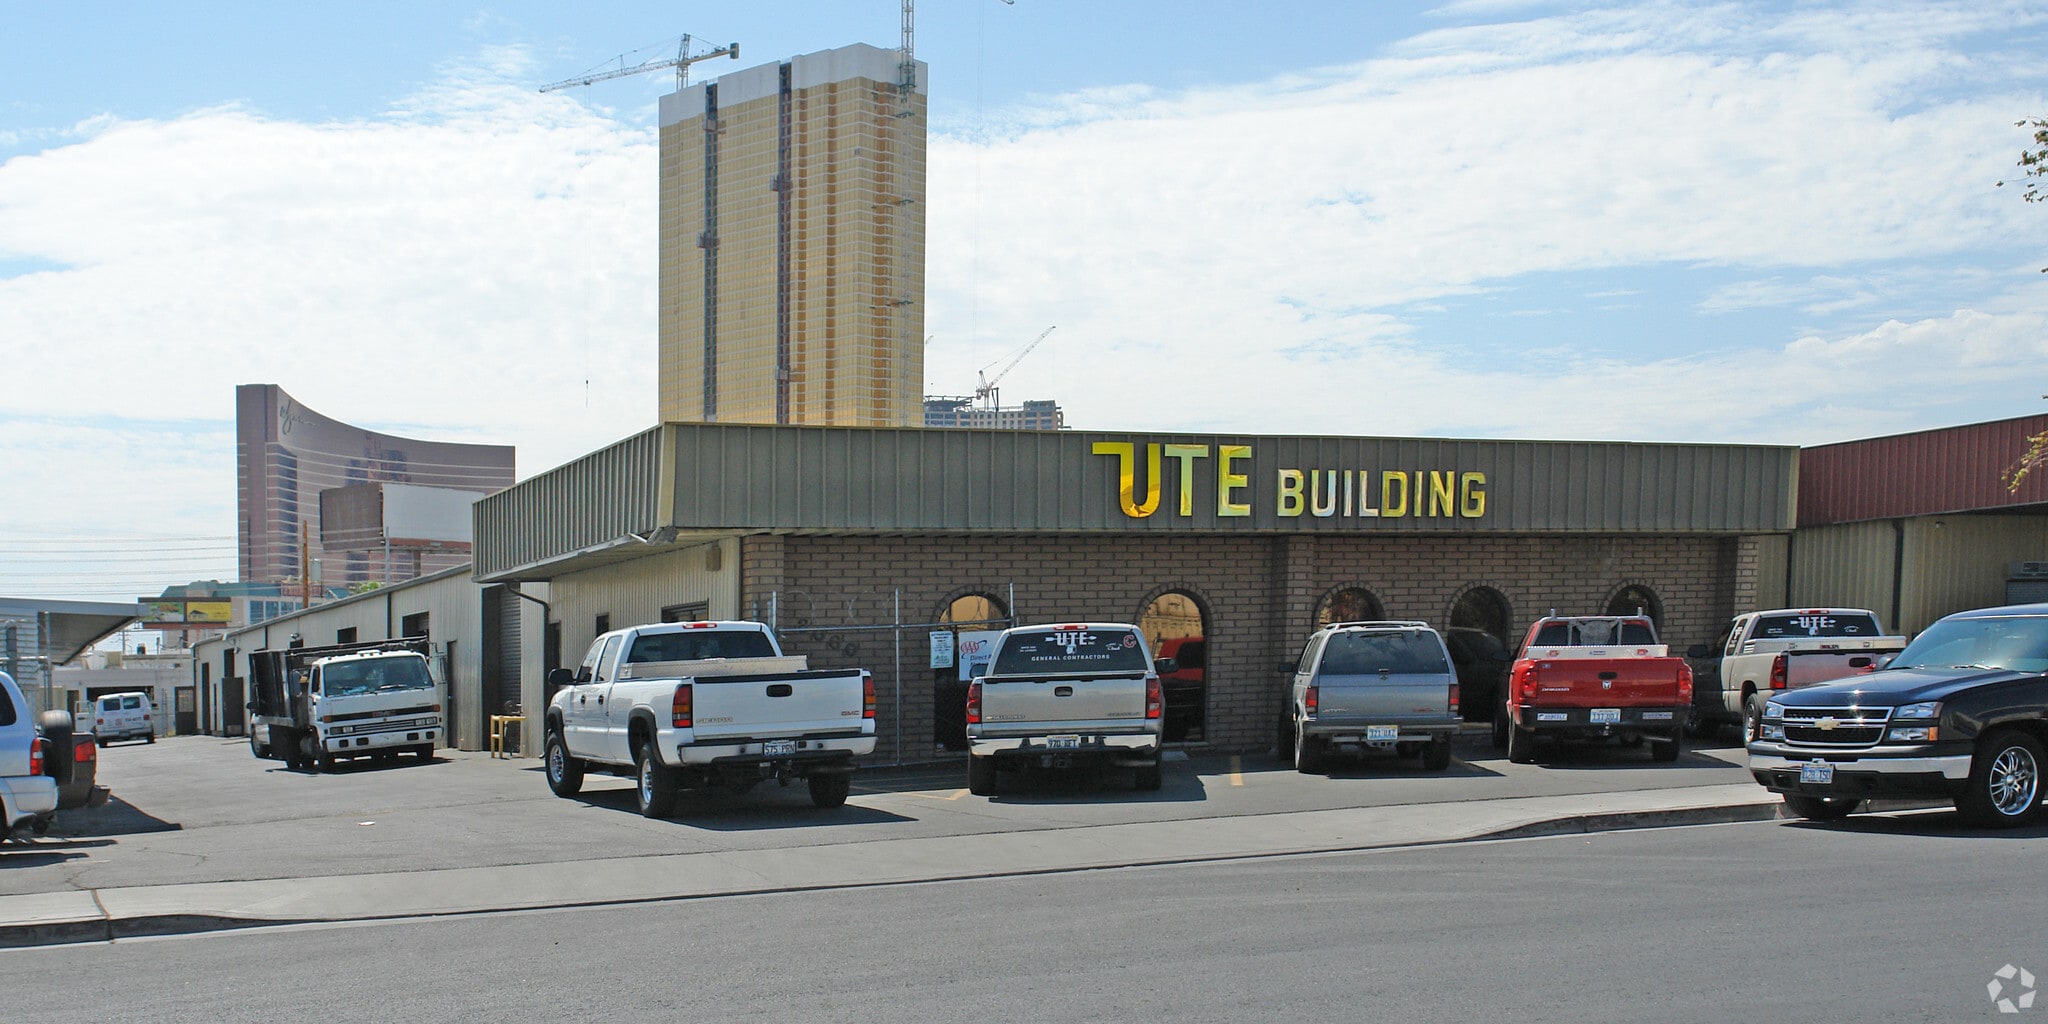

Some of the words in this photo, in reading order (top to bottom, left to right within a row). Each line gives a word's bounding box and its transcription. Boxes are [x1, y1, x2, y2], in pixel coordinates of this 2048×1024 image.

[1092, 442, 1252, 518] UTE
[1276, 468, 1487, 518] BUILDING
[1799, 616, 1828, 628] UTE
[1055, 632, 1087, 646] UTE
[765, 745, 778, 754] 575
